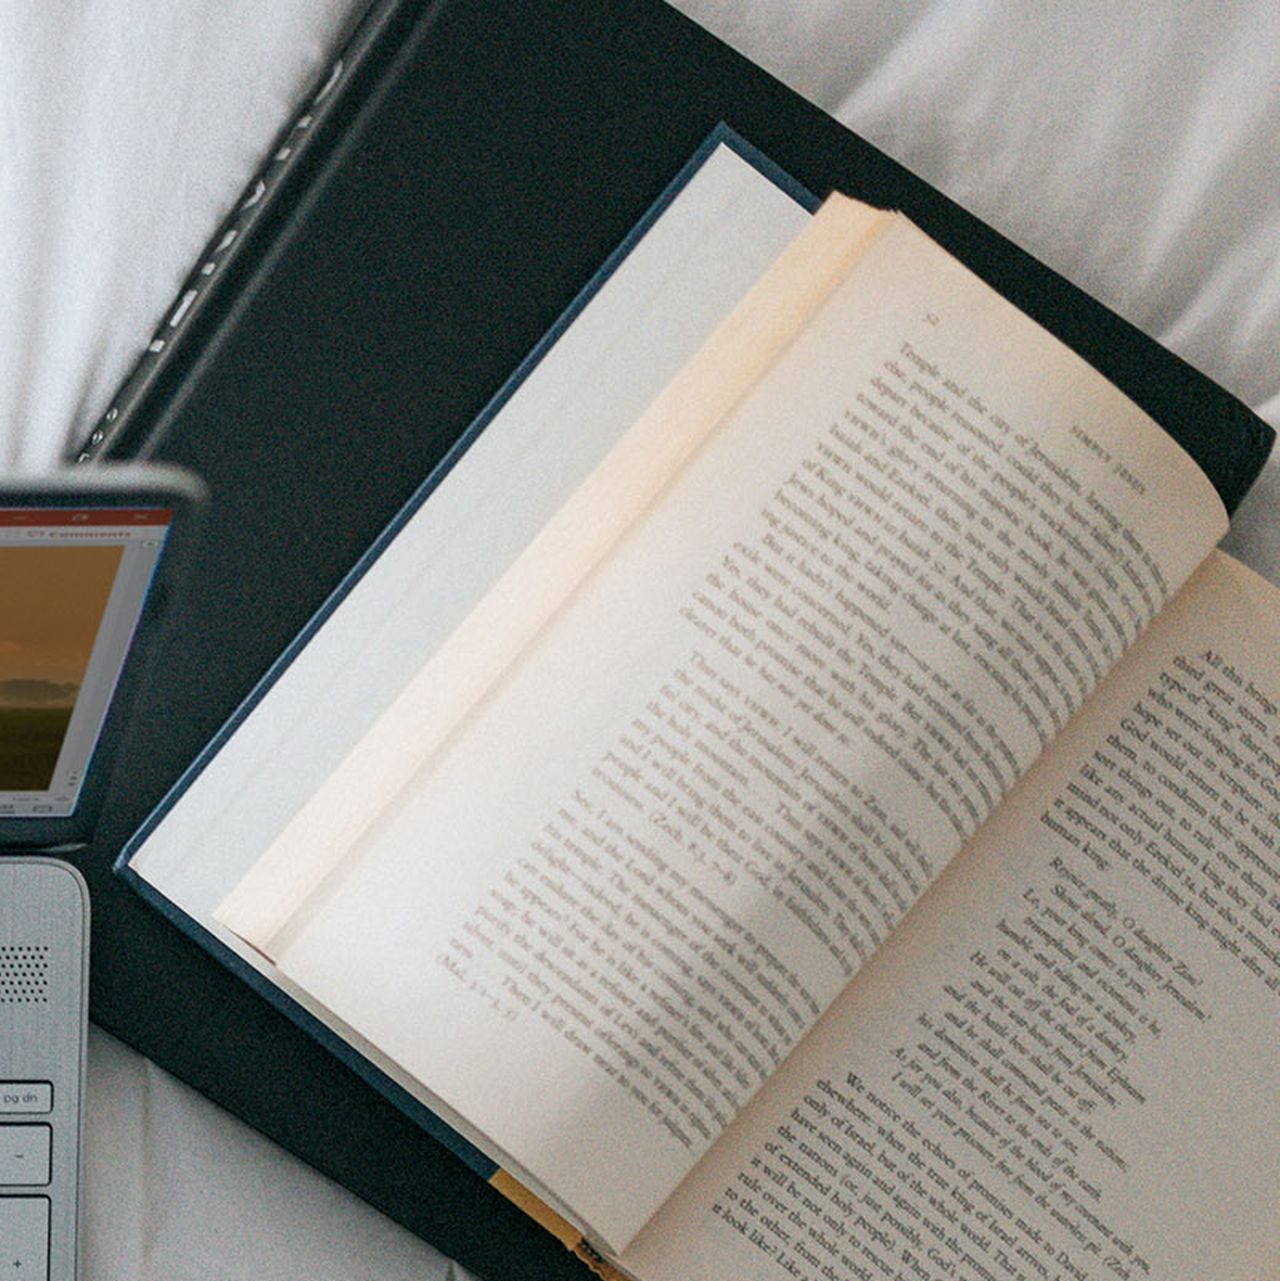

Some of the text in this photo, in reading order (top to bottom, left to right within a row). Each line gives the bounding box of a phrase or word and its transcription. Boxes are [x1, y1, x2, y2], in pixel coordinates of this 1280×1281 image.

[711, 1203, 722, 1214] it
[721, 1209, 747, 1234] look
[748, 1229, 777, 1253] like?
[775, 1252, 801, 1277] Like
